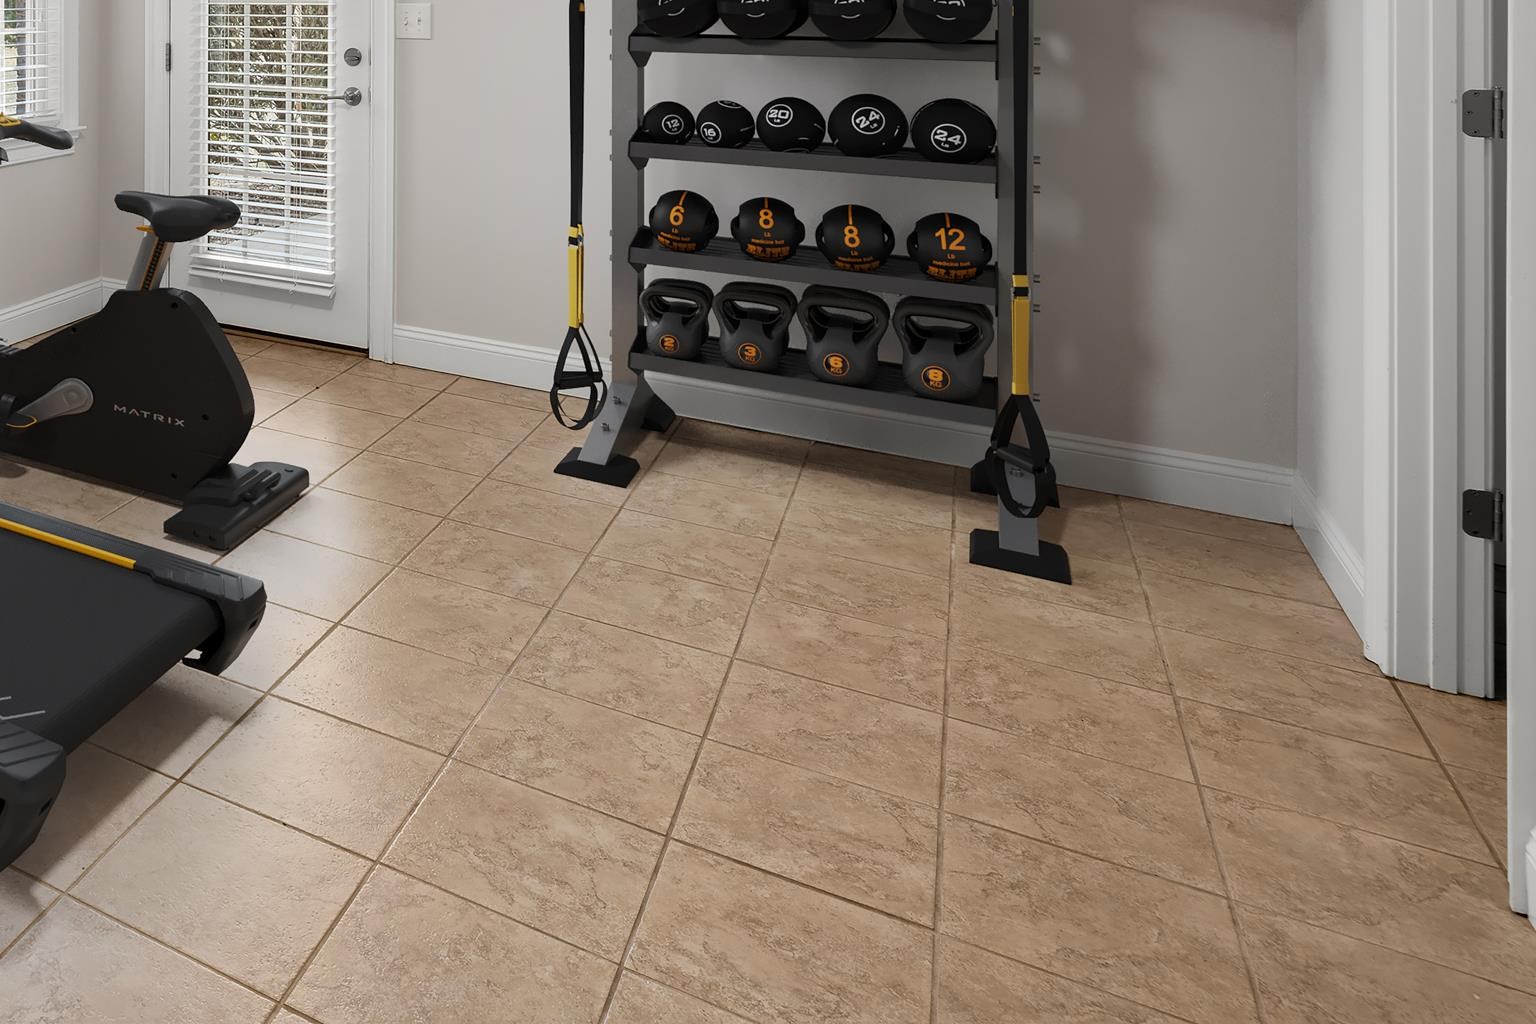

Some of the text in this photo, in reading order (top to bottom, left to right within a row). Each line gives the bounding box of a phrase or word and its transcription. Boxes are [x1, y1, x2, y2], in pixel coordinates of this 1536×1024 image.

[768, 109, 790, 119] 20
[855, 111, 880, 129] 24
[666, 119, 680, 128] 12
[703, 128, 716, 136] 16
[934, 129, 962, 145] 24
[669, 205, 684, 226] 6
[758, 208, 774, 229] 8
[844, 225, 861, 248] 8
[934, 227, 966, 250] 12
[663, 337, 675, 347] 2
[744, 346, 756, 356] 3
[829, 355, 843, 368] 6
[928, 369, 943, 381] 8
[113, 404, 185, 427] MATRIX
